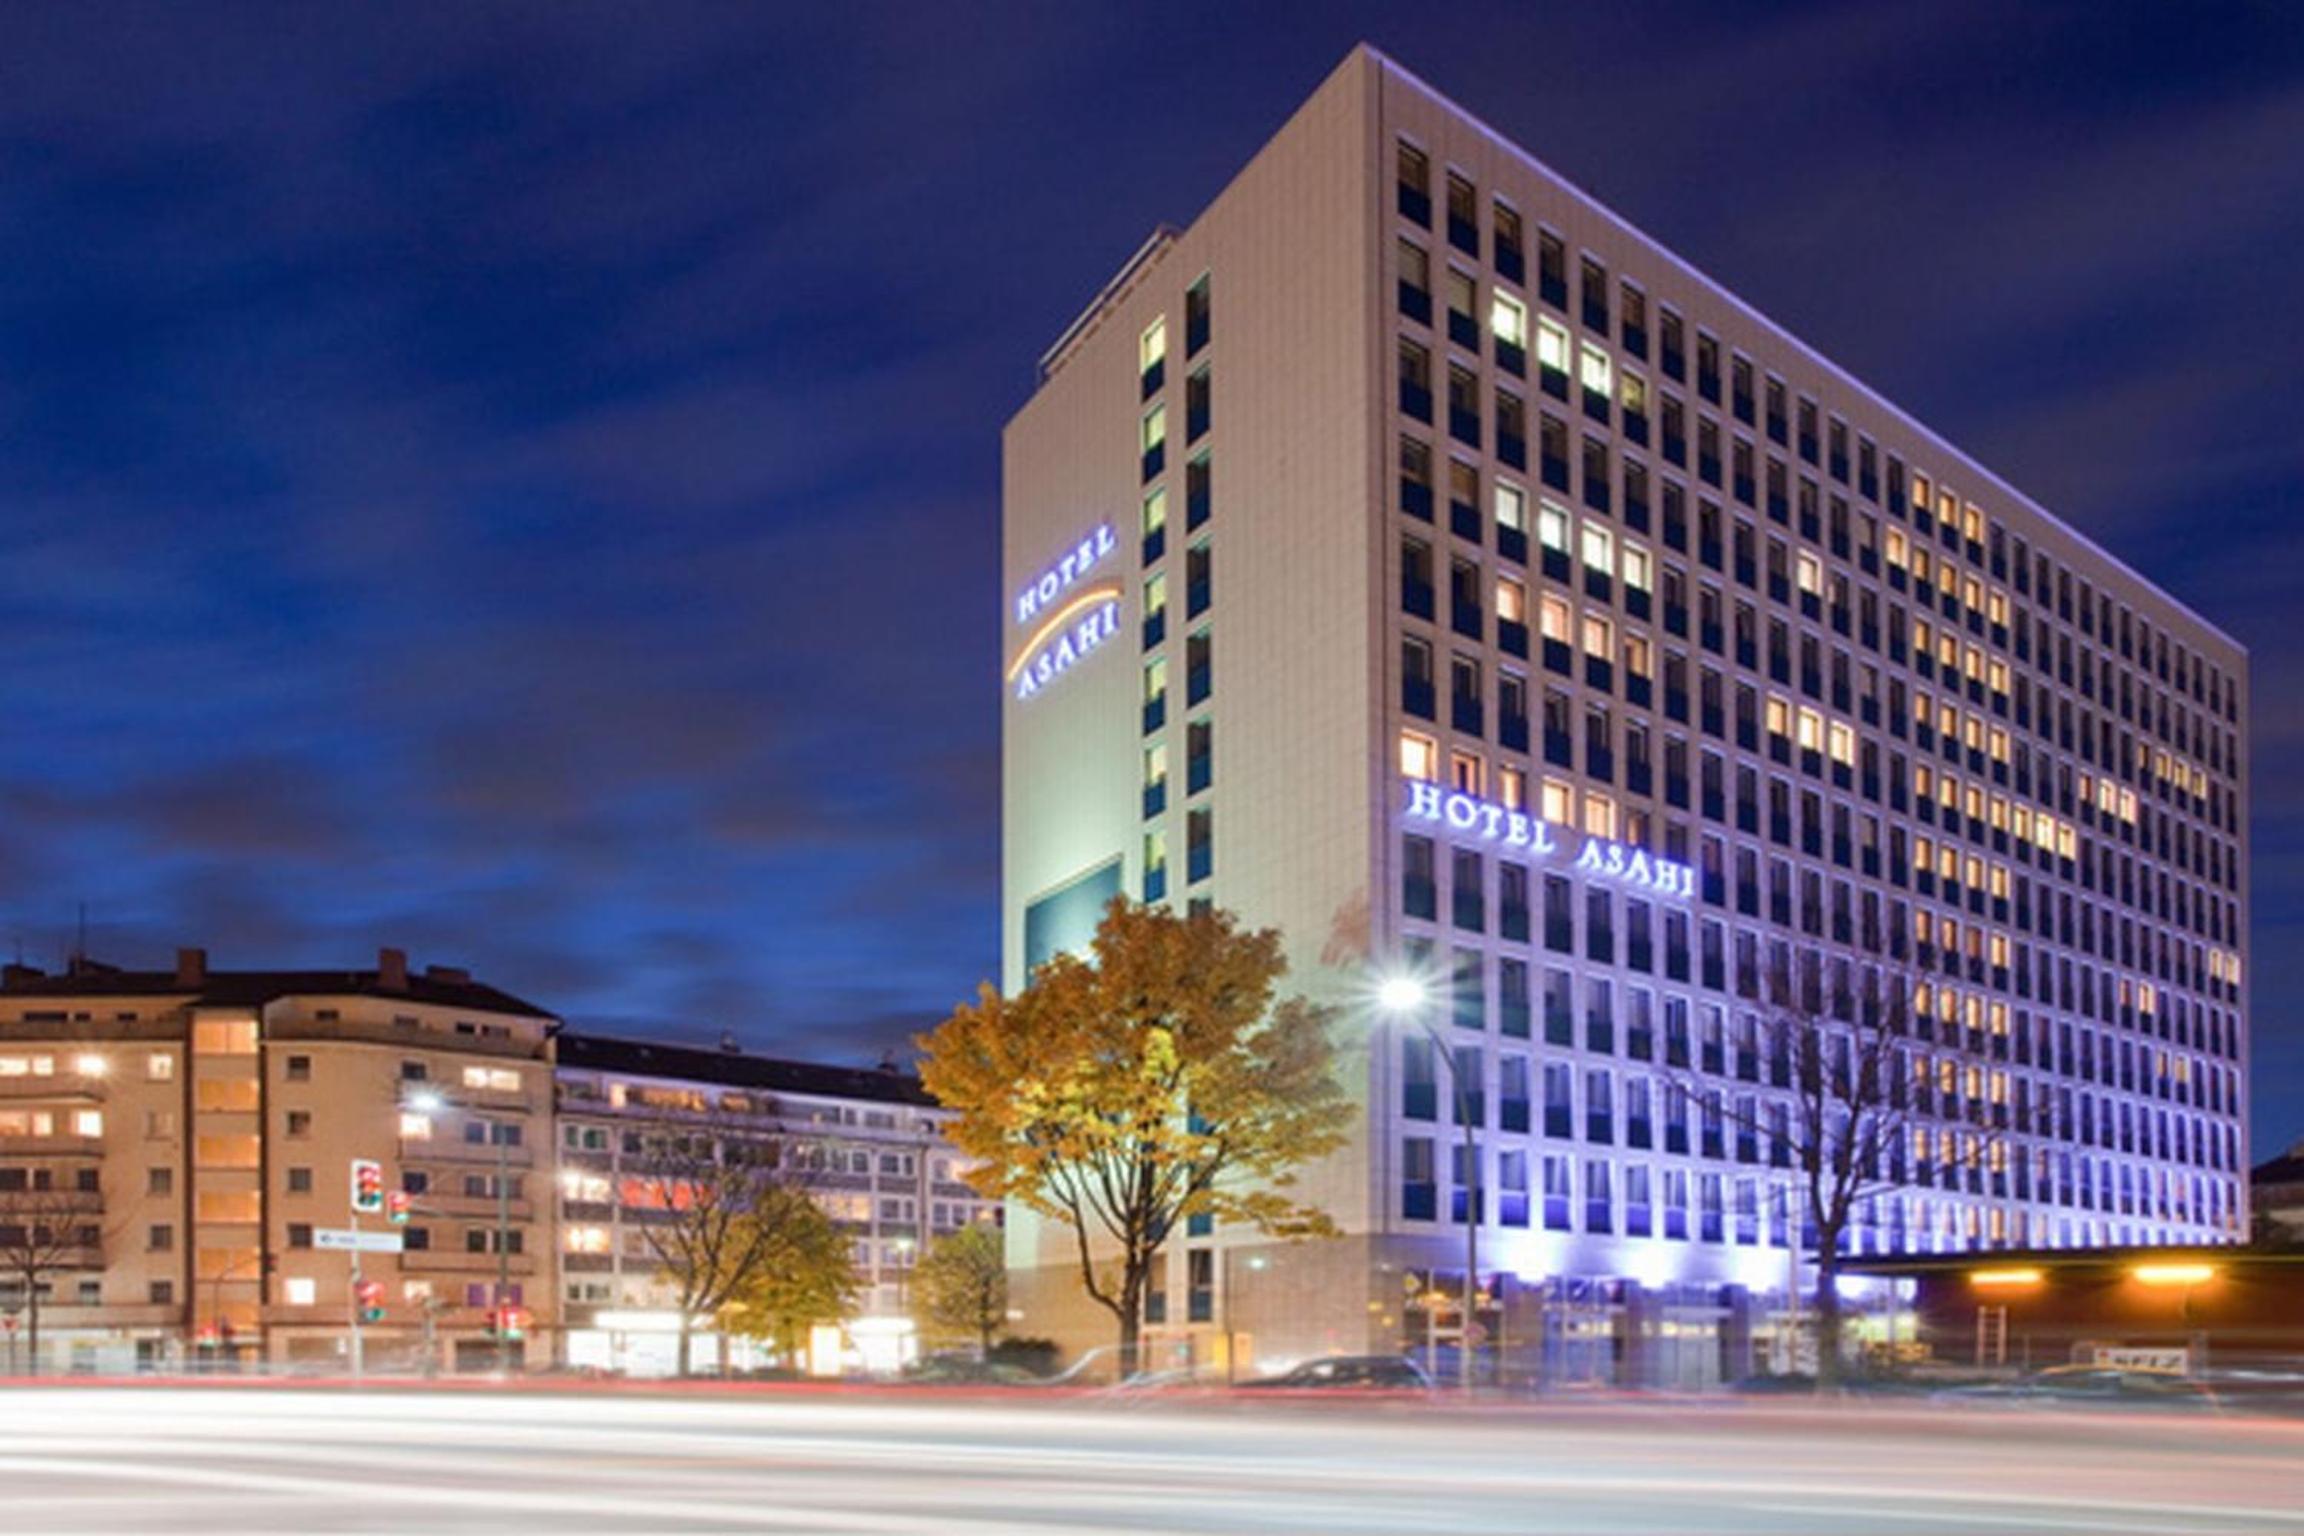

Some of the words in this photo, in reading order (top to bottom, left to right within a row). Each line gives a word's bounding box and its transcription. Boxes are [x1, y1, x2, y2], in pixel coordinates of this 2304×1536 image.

[1017, 523, 1116, 623] HOTEL
[1017, 601, 1119, 699] ASAHI
[1407, 781, 1556, 852] HOTEL
[1576, 838, 1696, 897] ASAHI
